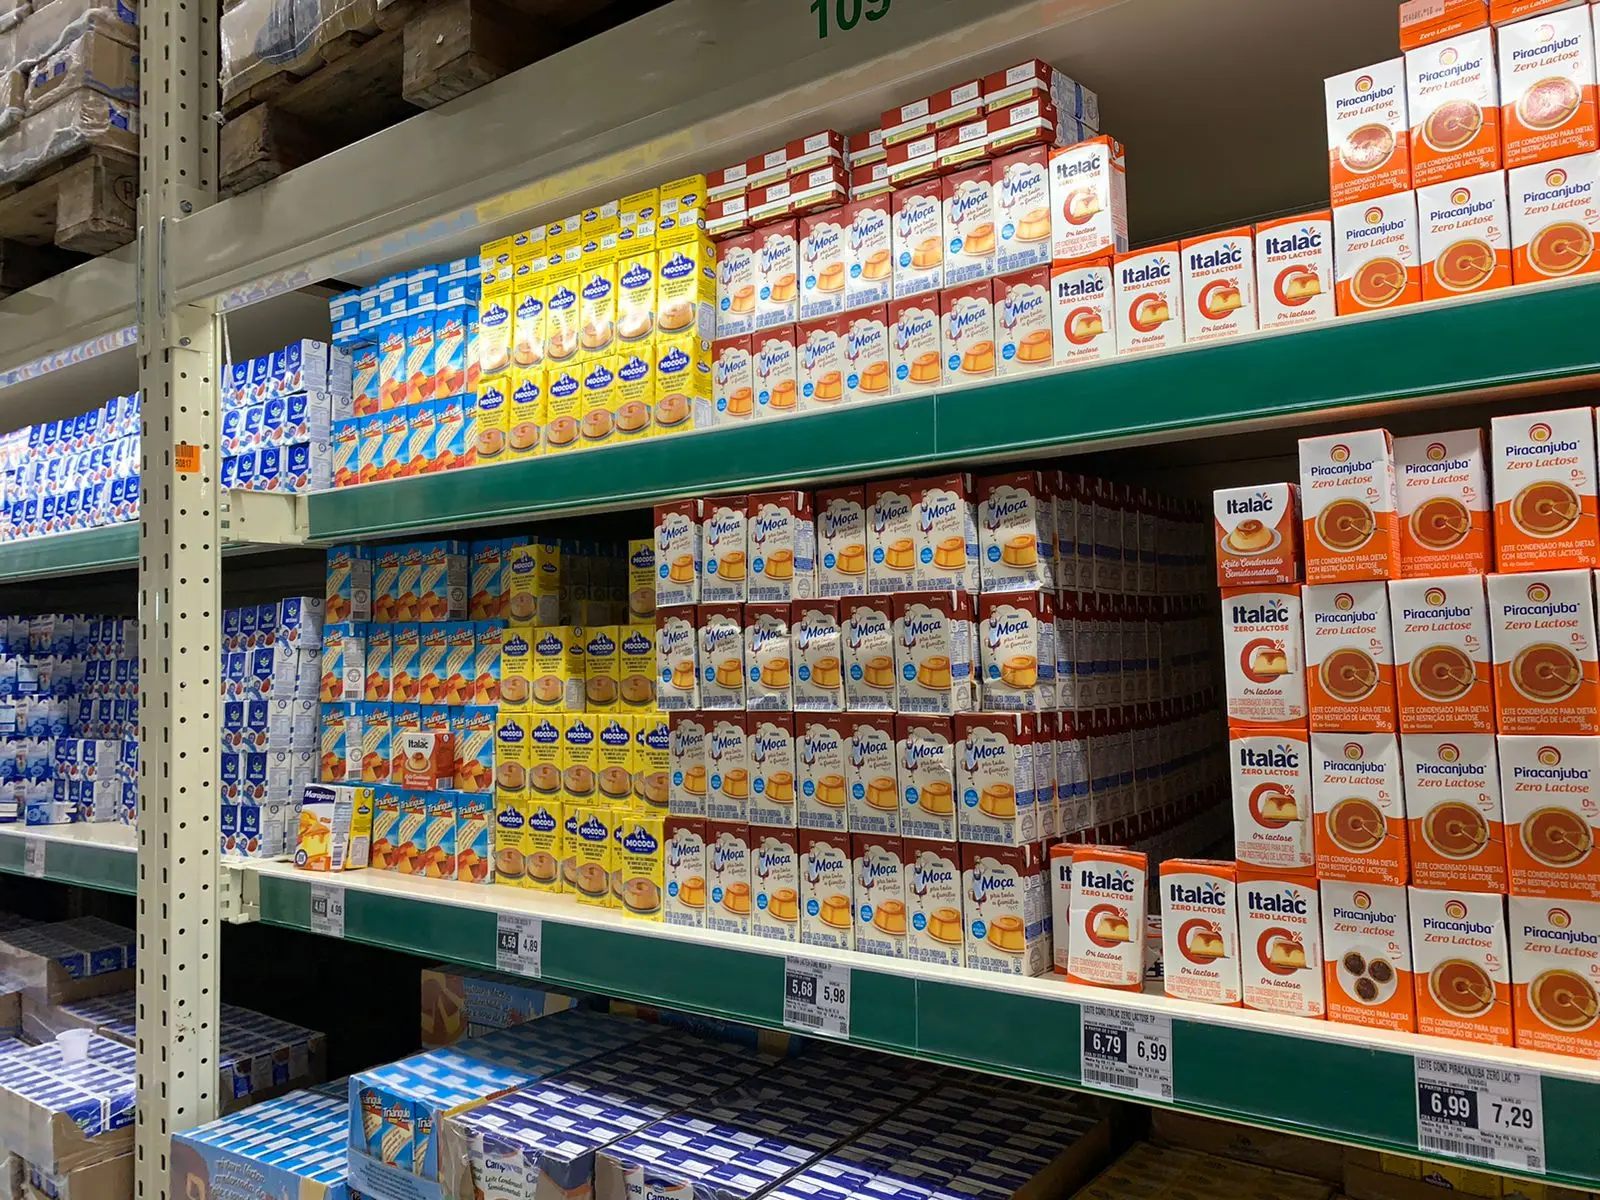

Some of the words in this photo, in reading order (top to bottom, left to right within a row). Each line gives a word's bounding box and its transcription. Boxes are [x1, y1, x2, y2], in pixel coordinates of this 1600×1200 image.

[1512, 36, 1578, 61] Piracanjuba
[1513, 61, 1538, 73] Zero
[1540, 50, 1579, 68] Lactose
[1419, 58, 1481, 83] Piracanjuba
[1419, 83, 1443, 95] Zero
[1444, 71, 1481, 89] Lactose
[1336, 85, 1395, 109] Piracanjuba
[1337, 109, 1358, 120] Zero
[1360, 98, 1394, 116] Lactose
[1057, 156, 1101, 179] Italac
[1010, 172, 1041, 194] Moça
[1523, 181, 1590, 203] Piracanjuba
[1430, 199, 1493, 221] Piracanjuba
[1524, 204, 1550, 216] Zero
[1551, 195, 1592, 212] Lactose
[907, 205, 936, 224] Moça
[1346, 219, 1404, 240] Piracanjuba
[1431, 222, 1455, 234] Zero
[1456, 213, 1494, 230] Lactose
[1265, 232, 1322, 256] Italac
[1347, 240, 1369, 252] Zero
[1370, 232, 1405, 249] Lactose
[768, 244, 792, 262] Moça
[1190, 247, 1242, 271] Italac
[1267, 254, 1287, 263] ZERO
[1288, 248, 1323, 260] LACTOSE
[661, 263, 693, 275] MOCOCA
[1122, 263, 1170, 285] Italac
[1191, 269, 1210, 278] ZERO
[1211, 264, 1242, 275] LACTOSE
[622, 273, 650, 287] MOCOCA
[1058, 277, 1103, 299] Italac
[1123, 283, 1141, 292] ZERO
[1141, 278, 1171, 289] LACTOSE
[1012, 296, 1043, 317] Moça
[1059, 297, 1076, 305] ZERO
[1077, 292, 1104, 303] LACTOSE
[904, 319, 933, 338] Moça
[658, 356, 689, 369] MOCOCA
[1505, 440, 1576, 458] Piracanjuba
[1311, 460, 1371, 478] Piracanjuba
[1405, 459, 1468, 475] Piracanjuba
[1506, 459, 1532, 470] Zero
[1534, 454, 1579, 468] Lactose
[1311, 478, 1334, 489] Zero
[1336, 474, 1373, 487] Lactose
[928, 501, 957, 518] Moça
[996, 499, 1028, 518] Moça
[1226, 498, 1273, 515] Italac
[762, 516, 788, 533] Moça
[1232, 606, 1289, 625] Italac
[1315, 611, 1375, 626] Piracanjuba
[1403, 606, 1471, 620] Piracanjuba
[1503, 603, 1577, 618] Piracanjuba
[806, 624, 836, 639] Moça
[997, 619, 1029, 635] Moça
[1234, 625, 1255, 633] ZERO
[1256, 624, 1289, 632] LACTOSE
[1404, 622, 1429, 633] Zero
[1431, 620, 1472, 631] Lactose
[1504, 619, 1531, 630] Zero
[1533, 618, 1579, 630] Lactose
[567, 731, 593, 740] MOCOCA
[601, 731, 629, 742] MOCOCA
[913, 743, 944, 759] Moça
[973, 744, 1006, 761] Moça
[1240, 748, 1299, 769] Italac
[1241, 768, 1263, 776] ZERO
[1264, 769, 1300, 777] LACTOSE
[1323, 760, 1383, 774] Piracanjuba
[1415, 762, 1484, 777] Piracanjuba
[1513, 767, 1587, 781] Piracanjuba
[1324, 774, 1346, 784] Zero
[1348, 775, 1385, 786] Lactose
[1515, 782, 1541, 792] Zero
[1544, 782, 1590, 794] Lactose
[580, 827, 607, 838] MOCOCA
[625, 838, 658, 849] MOCOCA
[815, 858, 844, 872] Moça
[981, 876, 1015, 892] Moça
[1081, 869, 1135, 893] Italac
[1081, 889, 1101, 898] ZERO
[1102, 892, 1134, 901] LACTOSE
[1170, 884, 1226, 906] Italac
[1248, 891, 1307, 915] Italac
[1171, 903, 1192, 912] ZERO
[1192, 905, 1226, 915] LACTOSE
[1249, 912, 1271, 921] ZERO
[1272, 914, 1308, 924] LACTOSE
[1423, 918, 1492, 935] Piracanjuba
[1333, 922, 1357, 933] Zero
[1523, 926, 1597, 944] Piracanjuba
[501, 935, 516, 950] 4,59
[523, 939, 538, 953] 4,89
[1424, 933, 1449, 944] Zero
[1451, 936, 1493, 948] Lactose
[1523, 941, 1552, 953] Zero
[1554, 945, 1599, 959] Lactose
[792, 980, 813, 997] 5,68
[824, 986, 845, 1004] 5,98
[1093, 1033, 1121, 1054] 6,79
[1137, 1040, 1166, 1061] 6,99
[1431, 1092, 1470, 1118] 6,99
[1492, 1103, 1533, 1129] 7,29
